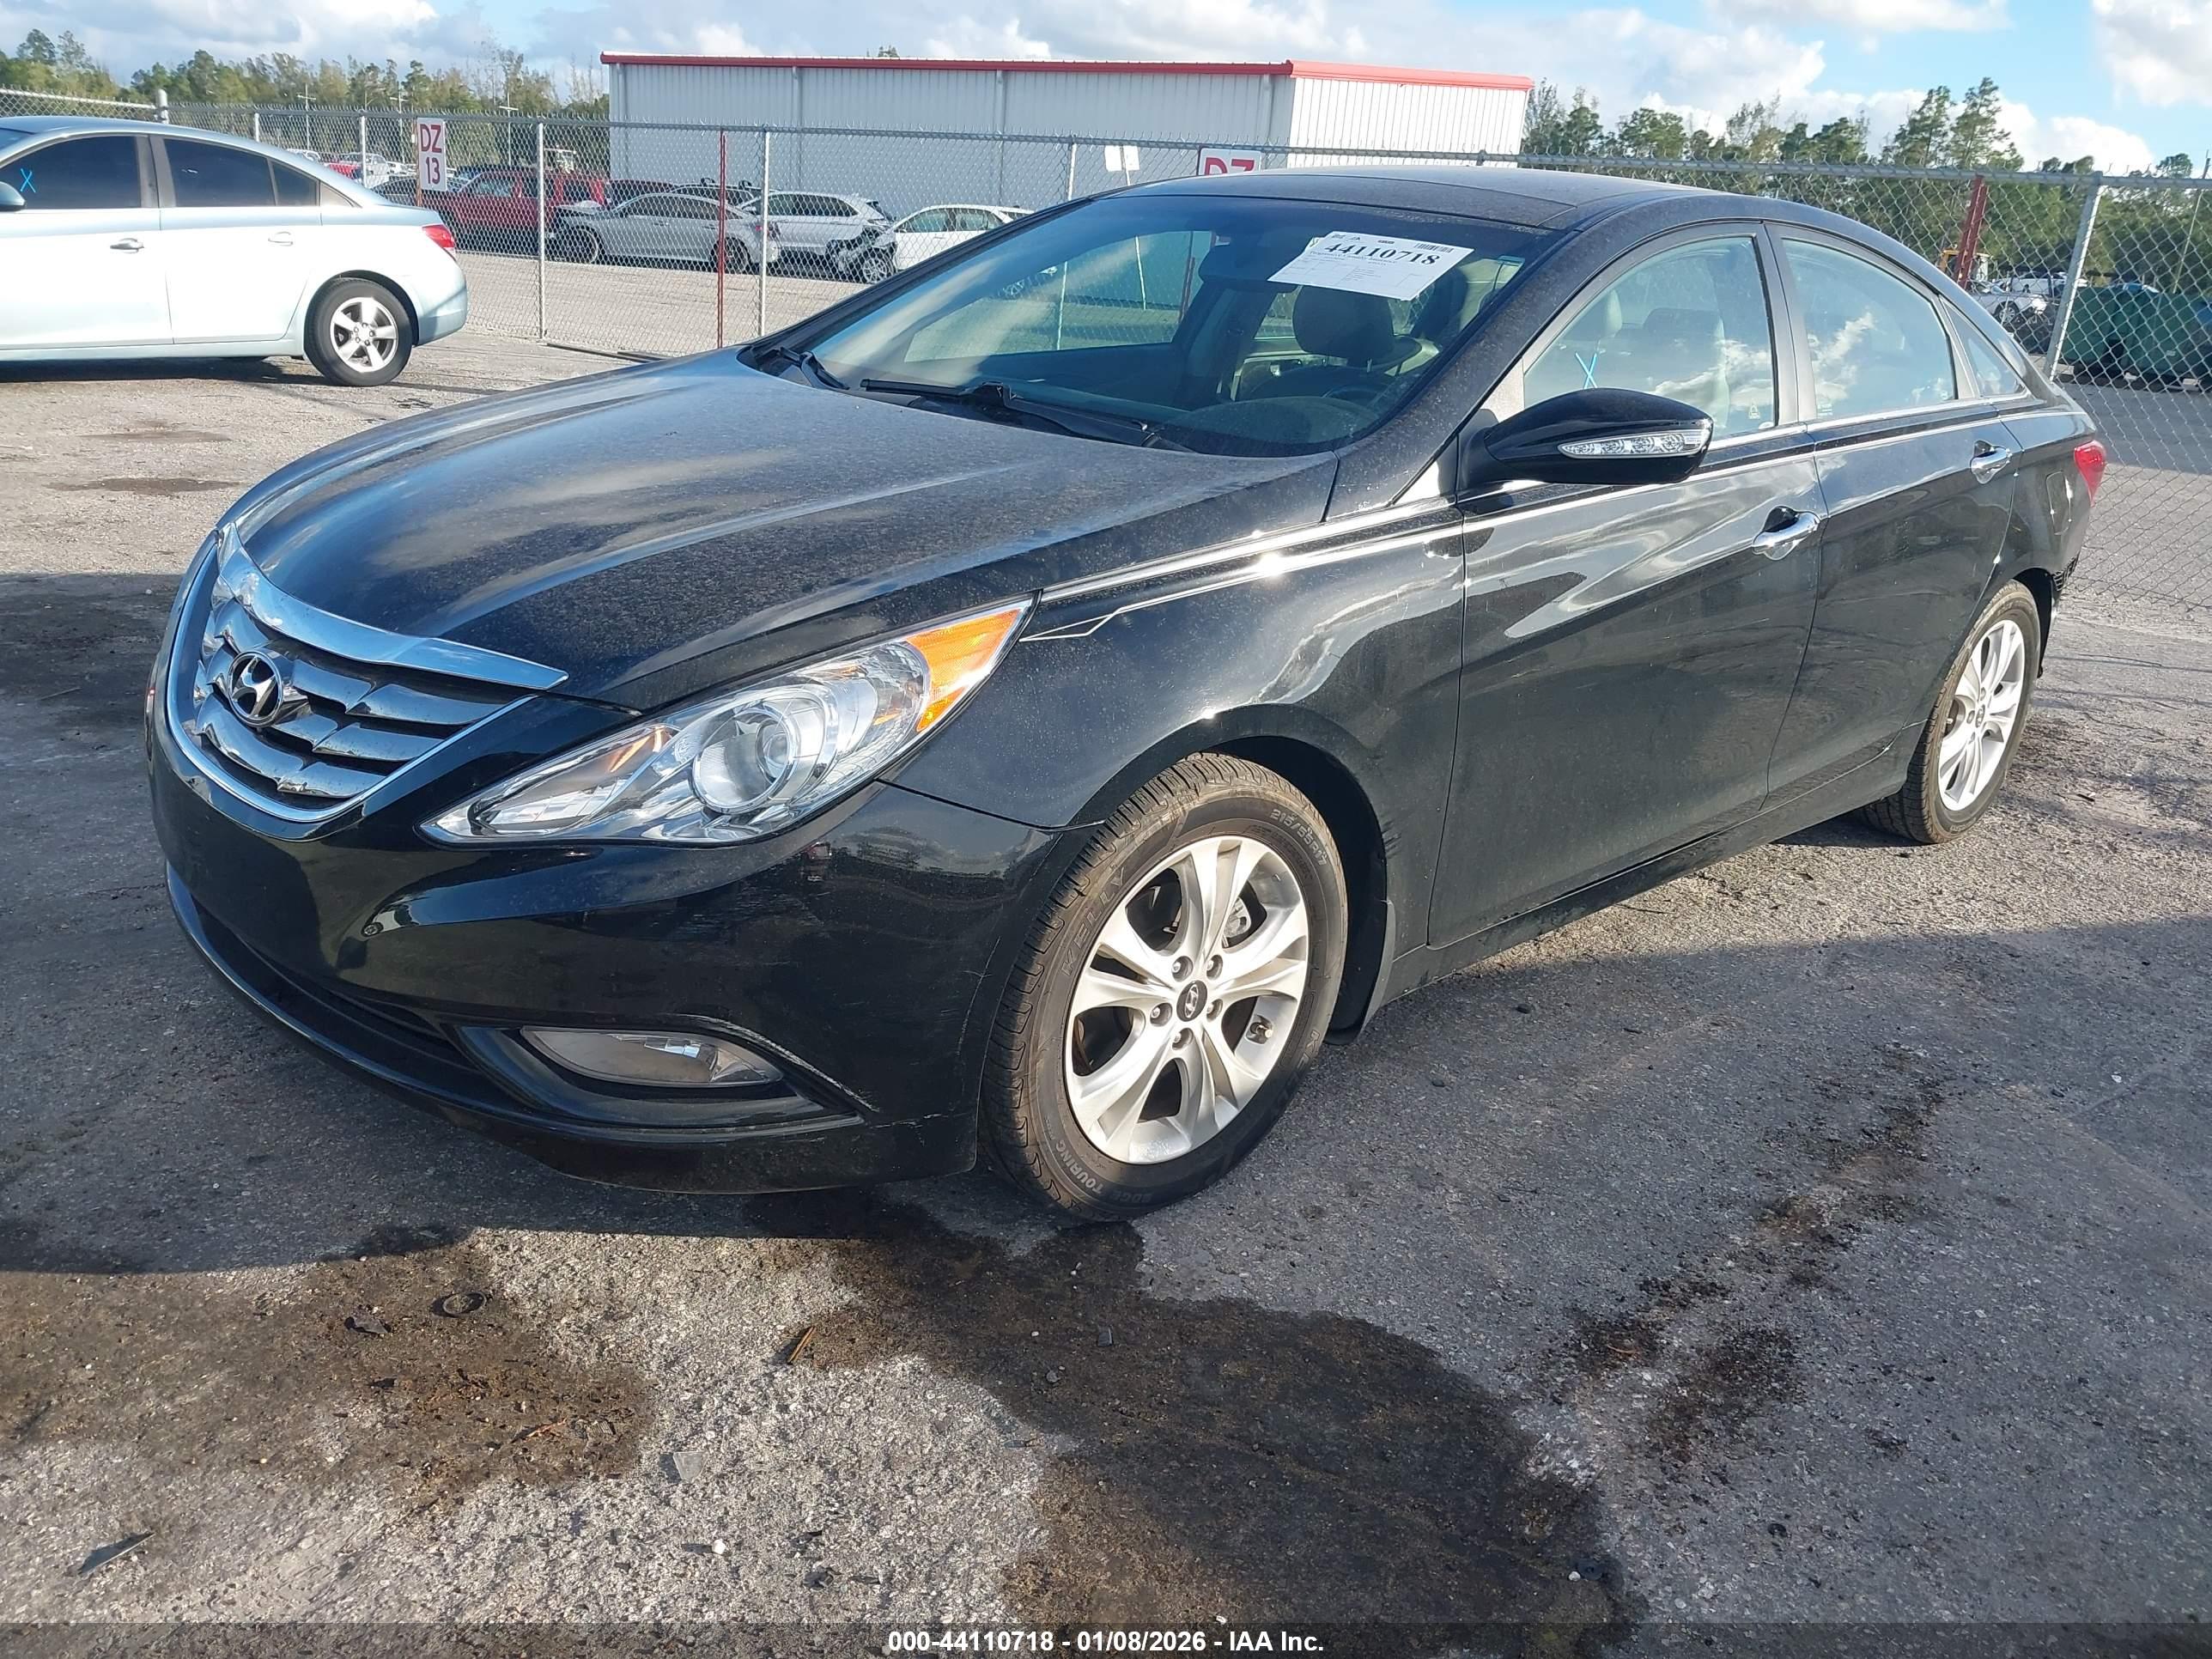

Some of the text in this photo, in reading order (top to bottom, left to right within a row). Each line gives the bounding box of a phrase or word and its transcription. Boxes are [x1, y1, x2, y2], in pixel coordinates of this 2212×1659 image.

[420, 124, 442, 153] DZ
[426, 156, 441, 185] 13
[1325, 242, 1441, 265] 44110718
[1269, 809, 1328, 866] 215/55R17
[1060, 866, 1127, 977] KELLY
[1055, 1139, 1104, 1194] TOURING
